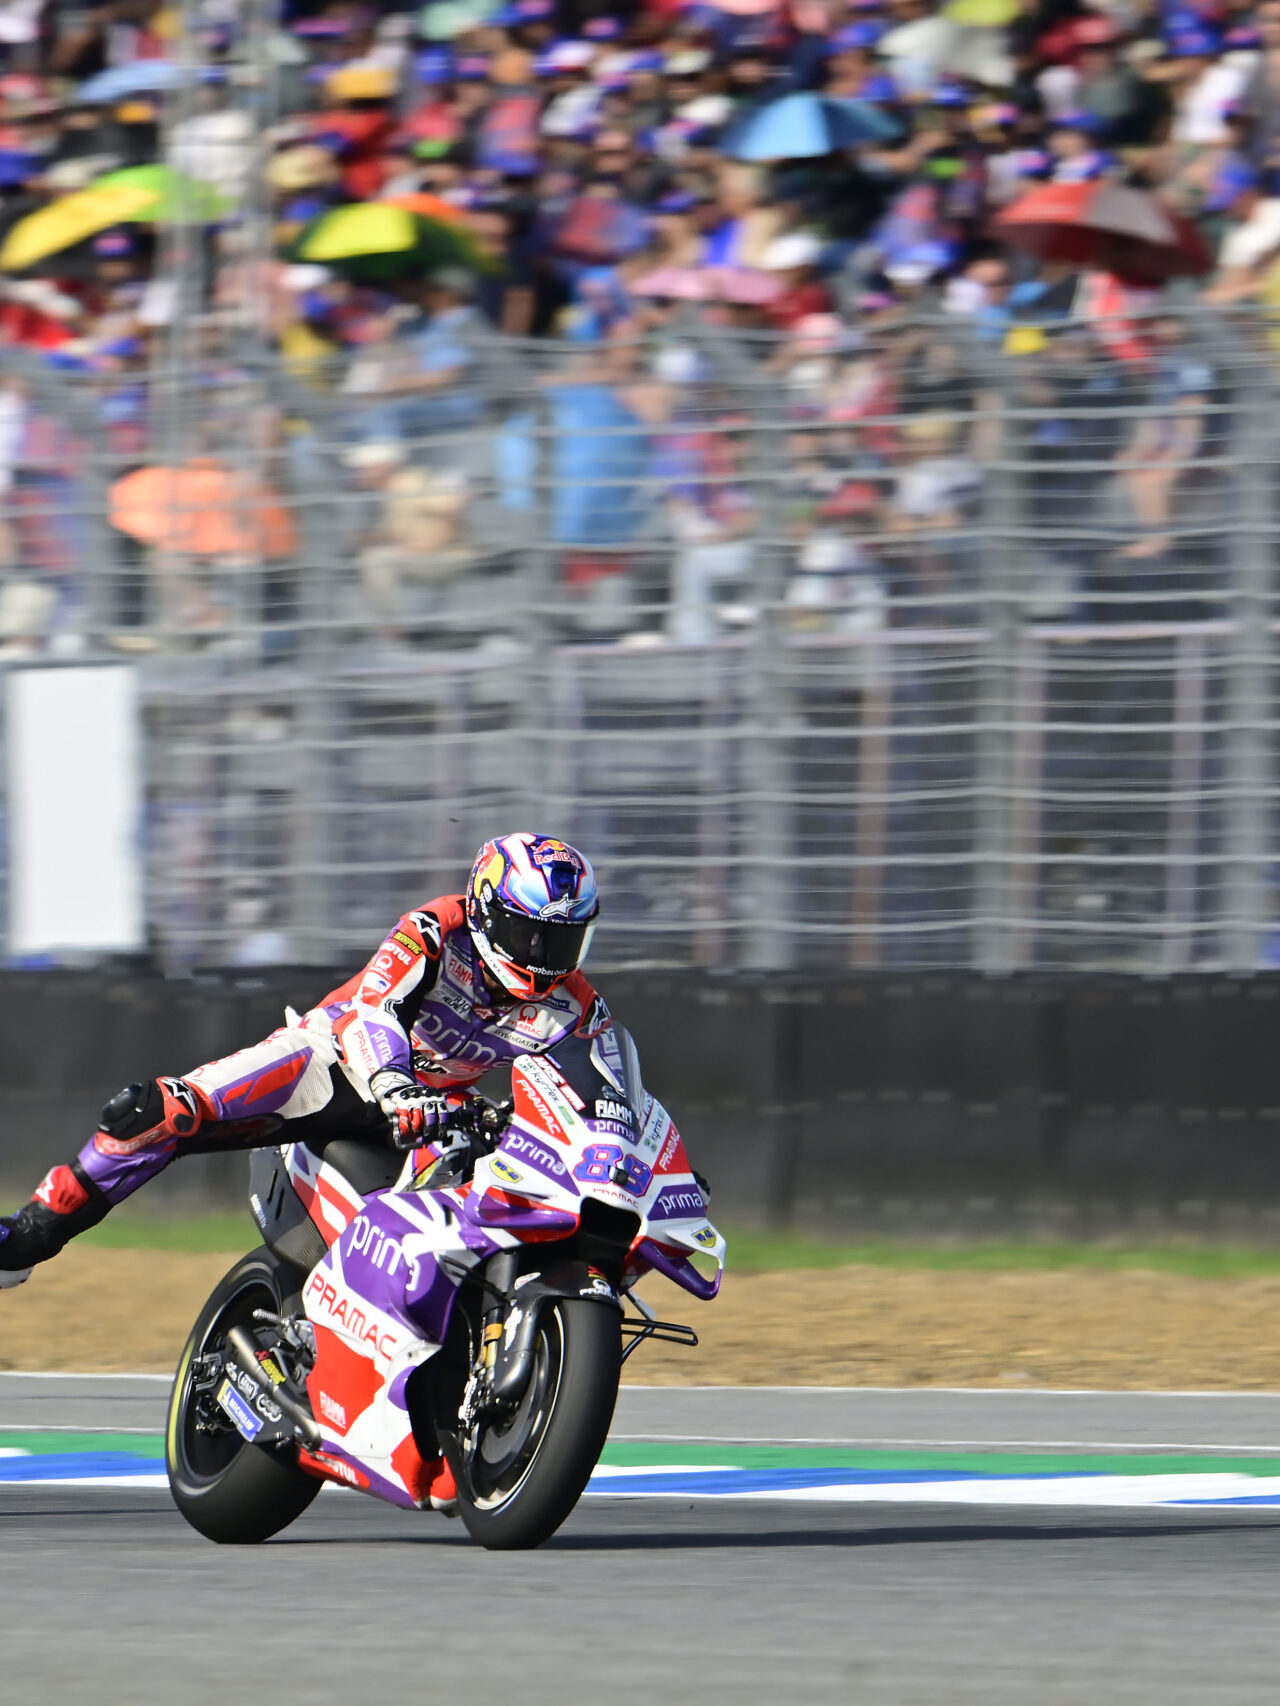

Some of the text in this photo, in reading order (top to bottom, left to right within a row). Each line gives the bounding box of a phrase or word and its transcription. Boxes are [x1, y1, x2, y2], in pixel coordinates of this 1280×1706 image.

[534, 851, 559, 865] Red
[516, 1079, 561, 1135] PRAMAC
[595, 1099, 634, 1124] FIAMM
[593, 1119, 636, 1141] prima
[659, 1129, 681, 1172] PRAMAC
[504, 1133, 567, 1176] prima
[572, 1143, 654, 1198] 89
[657, 1191, 705, 1215] prima
[306, 1271, 397, 1361] PRAMAC
